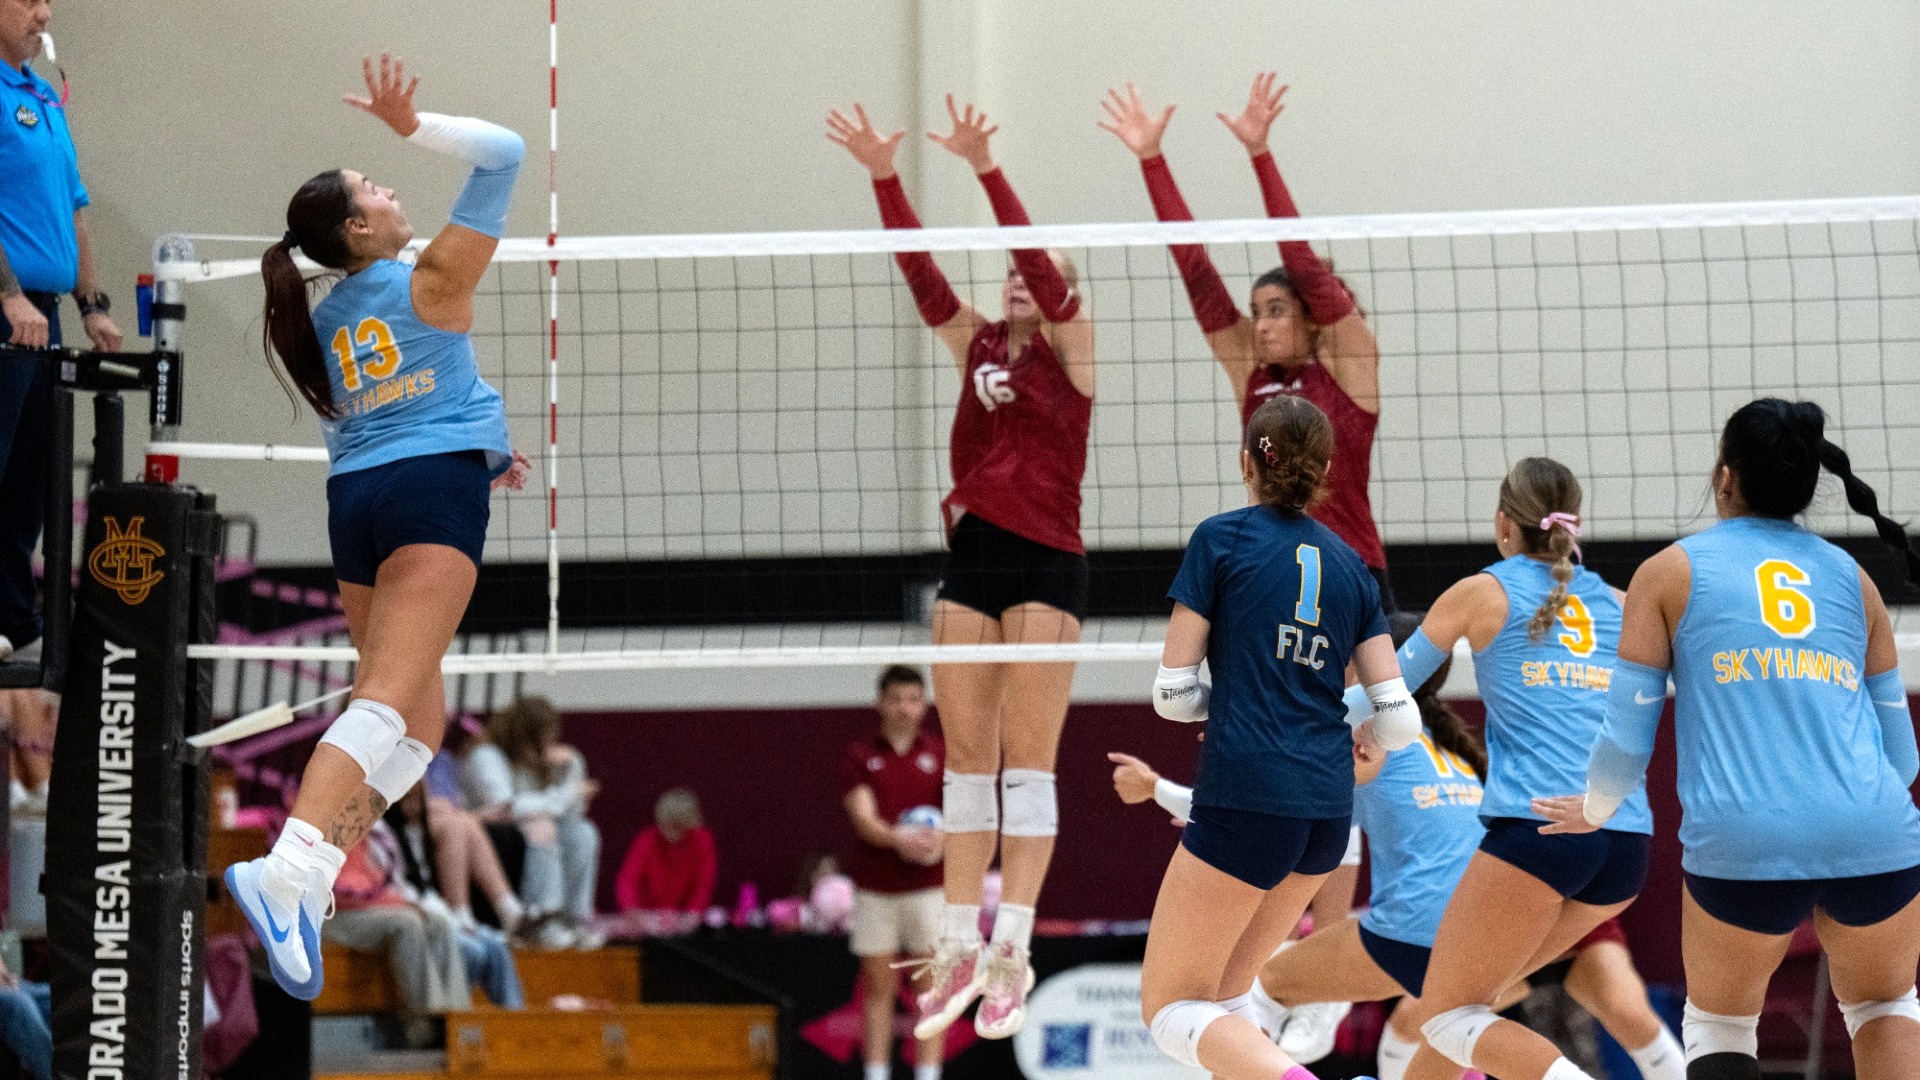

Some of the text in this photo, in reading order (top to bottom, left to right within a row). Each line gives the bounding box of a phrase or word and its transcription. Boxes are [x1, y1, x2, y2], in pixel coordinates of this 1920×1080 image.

[331, 316, 402, 393] 13
[1295, 543, 1322, 628] 1
[1754, 559, 1816, 639] 6
[1276, 623, 1329, 670] FLC
[1553, 594, 1597, 659] 9
[1521, 661, 1614, 693] SKYHAW
[1712, 648, 1859, 693] SKYHAWKS
[97, 638, 137, 852] UNIVERSITY
[94, 859, 131, 960] MESA
[180, 909, 193, 987] sports
